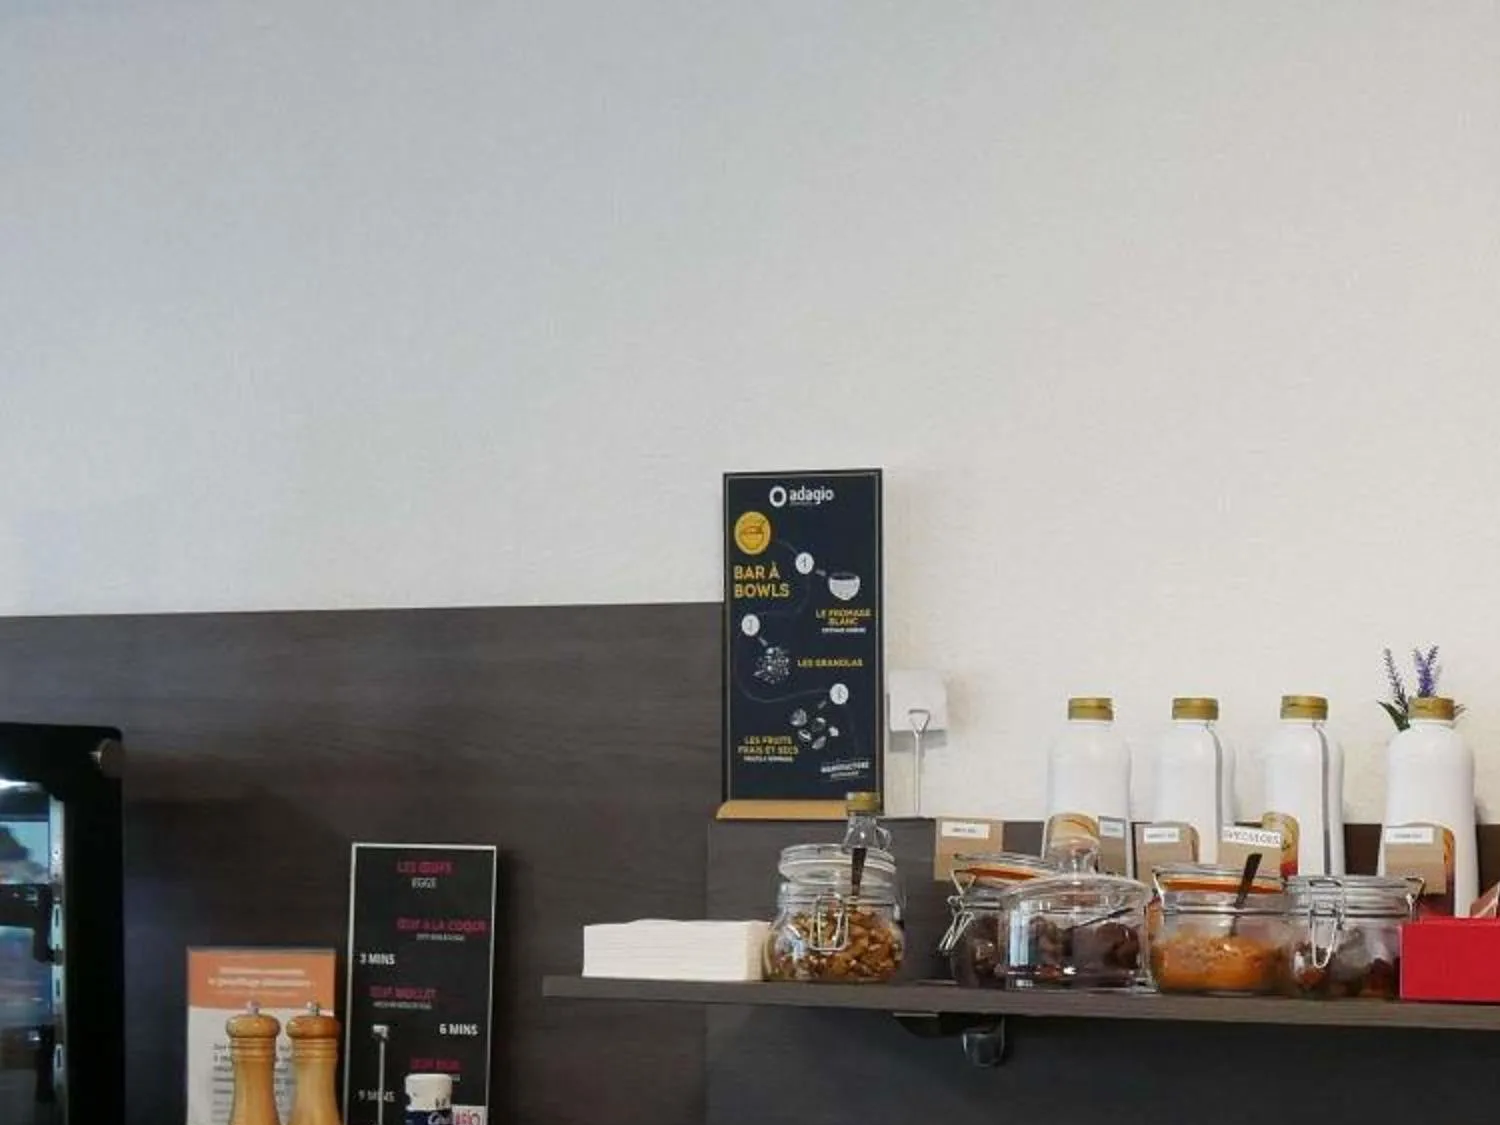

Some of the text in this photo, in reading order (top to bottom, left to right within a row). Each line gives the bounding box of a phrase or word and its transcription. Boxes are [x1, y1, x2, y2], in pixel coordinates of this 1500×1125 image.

[789, 486, 834, 504] adagio
[734, 562, 780, 579] BAR À
[734, 583, 790, 598] BOWLS
[369, 954, 396, 965] MINS
[439, 1024, 478, 1035] 6 MINS
